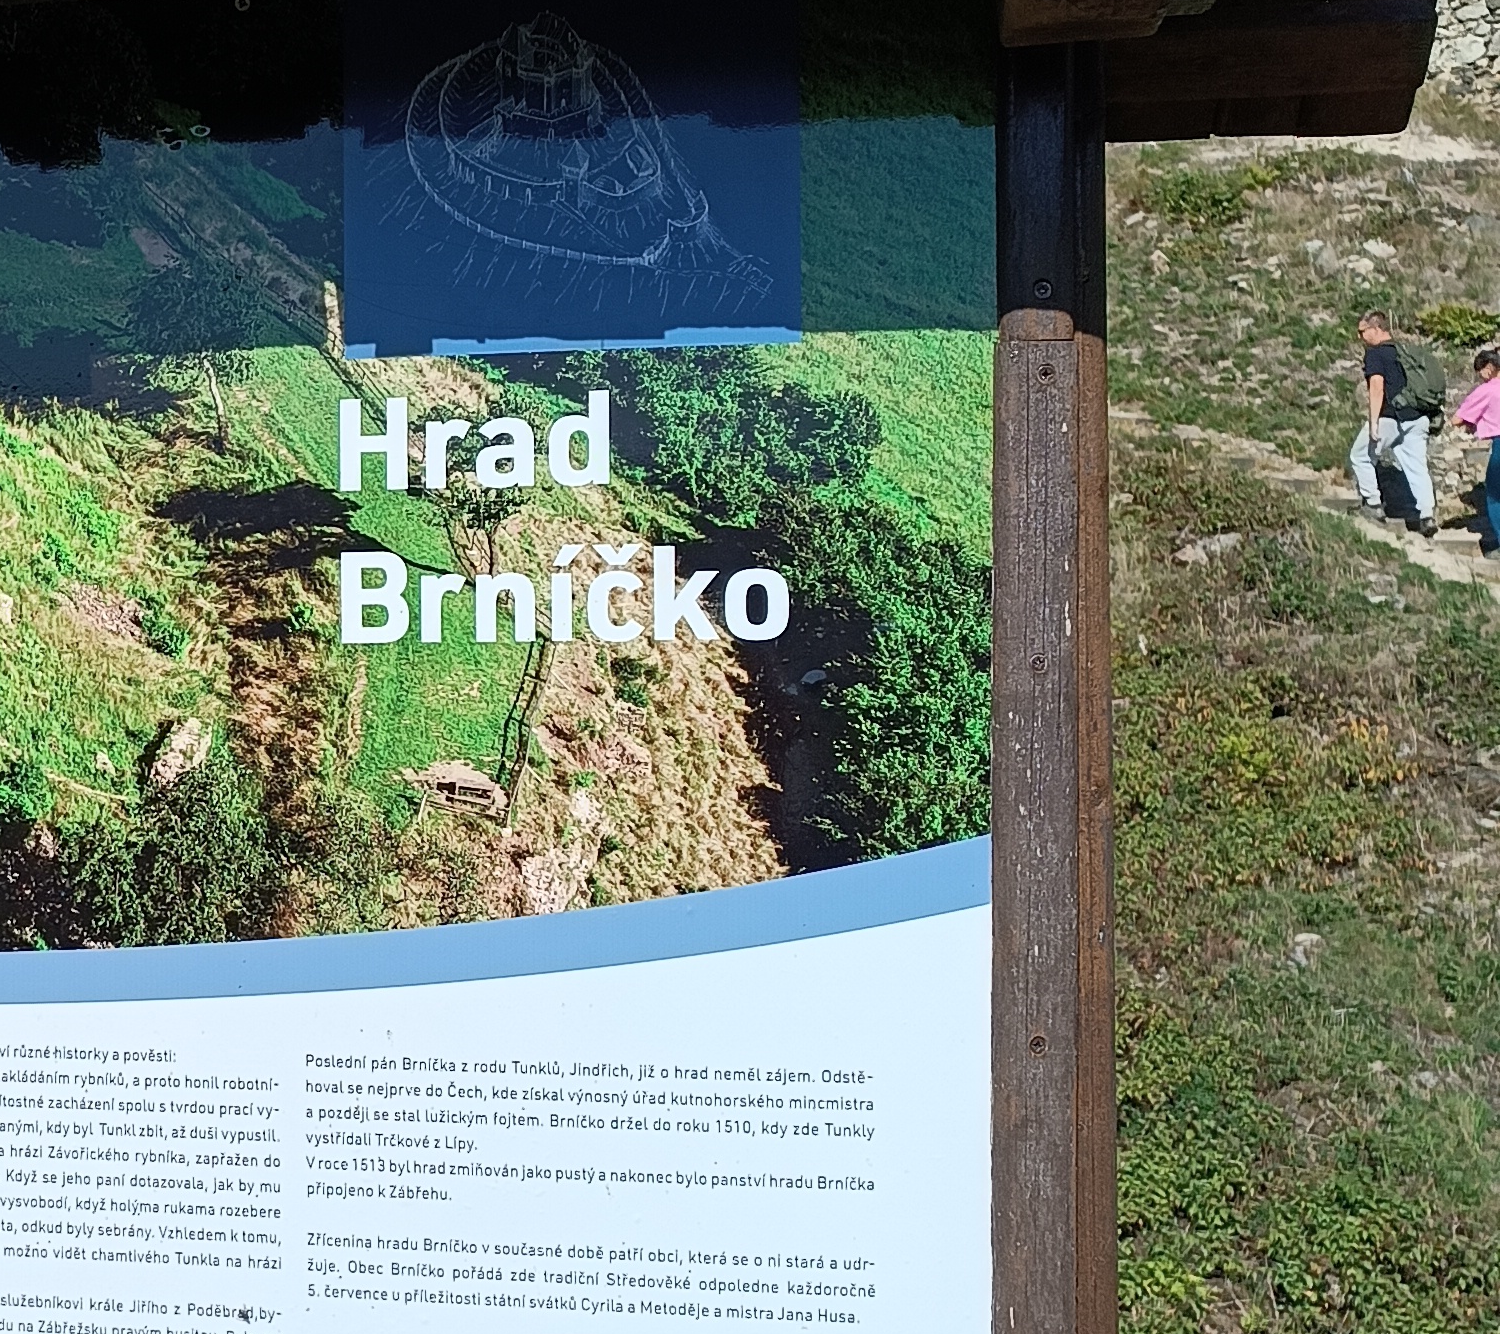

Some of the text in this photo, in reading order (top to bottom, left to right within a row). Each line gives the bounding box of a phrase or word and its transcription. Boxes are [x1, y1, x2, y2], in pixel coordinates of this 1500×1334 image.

[338, 390, 612, 493] Hrad
[339, 543, 789, 645] Brníčko
[13, 1043, 51, 1059] různé
[111, 1050, 120, 1061] a
[123, 1048, 177, 1065] pověsti:
[305, 1053, 367, 1070] Poslední
[371, 1055, 397, 1074] pán
[402, 1056, 456, 1073] Brníčka
[460, 1061, 469, 1073] z
[473, 1059, 507, 1074] rodu
[511, 1060, 565, 1079] Tunklů,
[568, 1062, 634, 1081] Jindřich,
[660, 1068, 669, 1079] o
[674, 1065, 709, 1080] hrad
[714, 1067, 762, 1082] neměl
[765, 1067, 816, 1086] zájem.
[821, 1069, 874, 1085] Odstě-
[305, 1104, 876, 1142] a později se stal lužickým fojtem. Brníčko držel do roku 1510, kdy zde Tunkly
[9, 1143, 43, 1159] hrázi
[47, 1145, 130, 1163] Závořického
[134, 1148, 190, 1168] rybníka,
[195, 1152, 259, 1169] zapřažen
[263, 1153, 281, 1168] do
[305, 1131, 478, 1154] vystřídali Trčkové z Lípy.
[307, 1181, 453, 1202] připojeno k Zábřehu.
[307, 1257, 876, 1298] žuje. Obec Brníčko pořádá zde tradiční Středověké odpoledne každoročně
